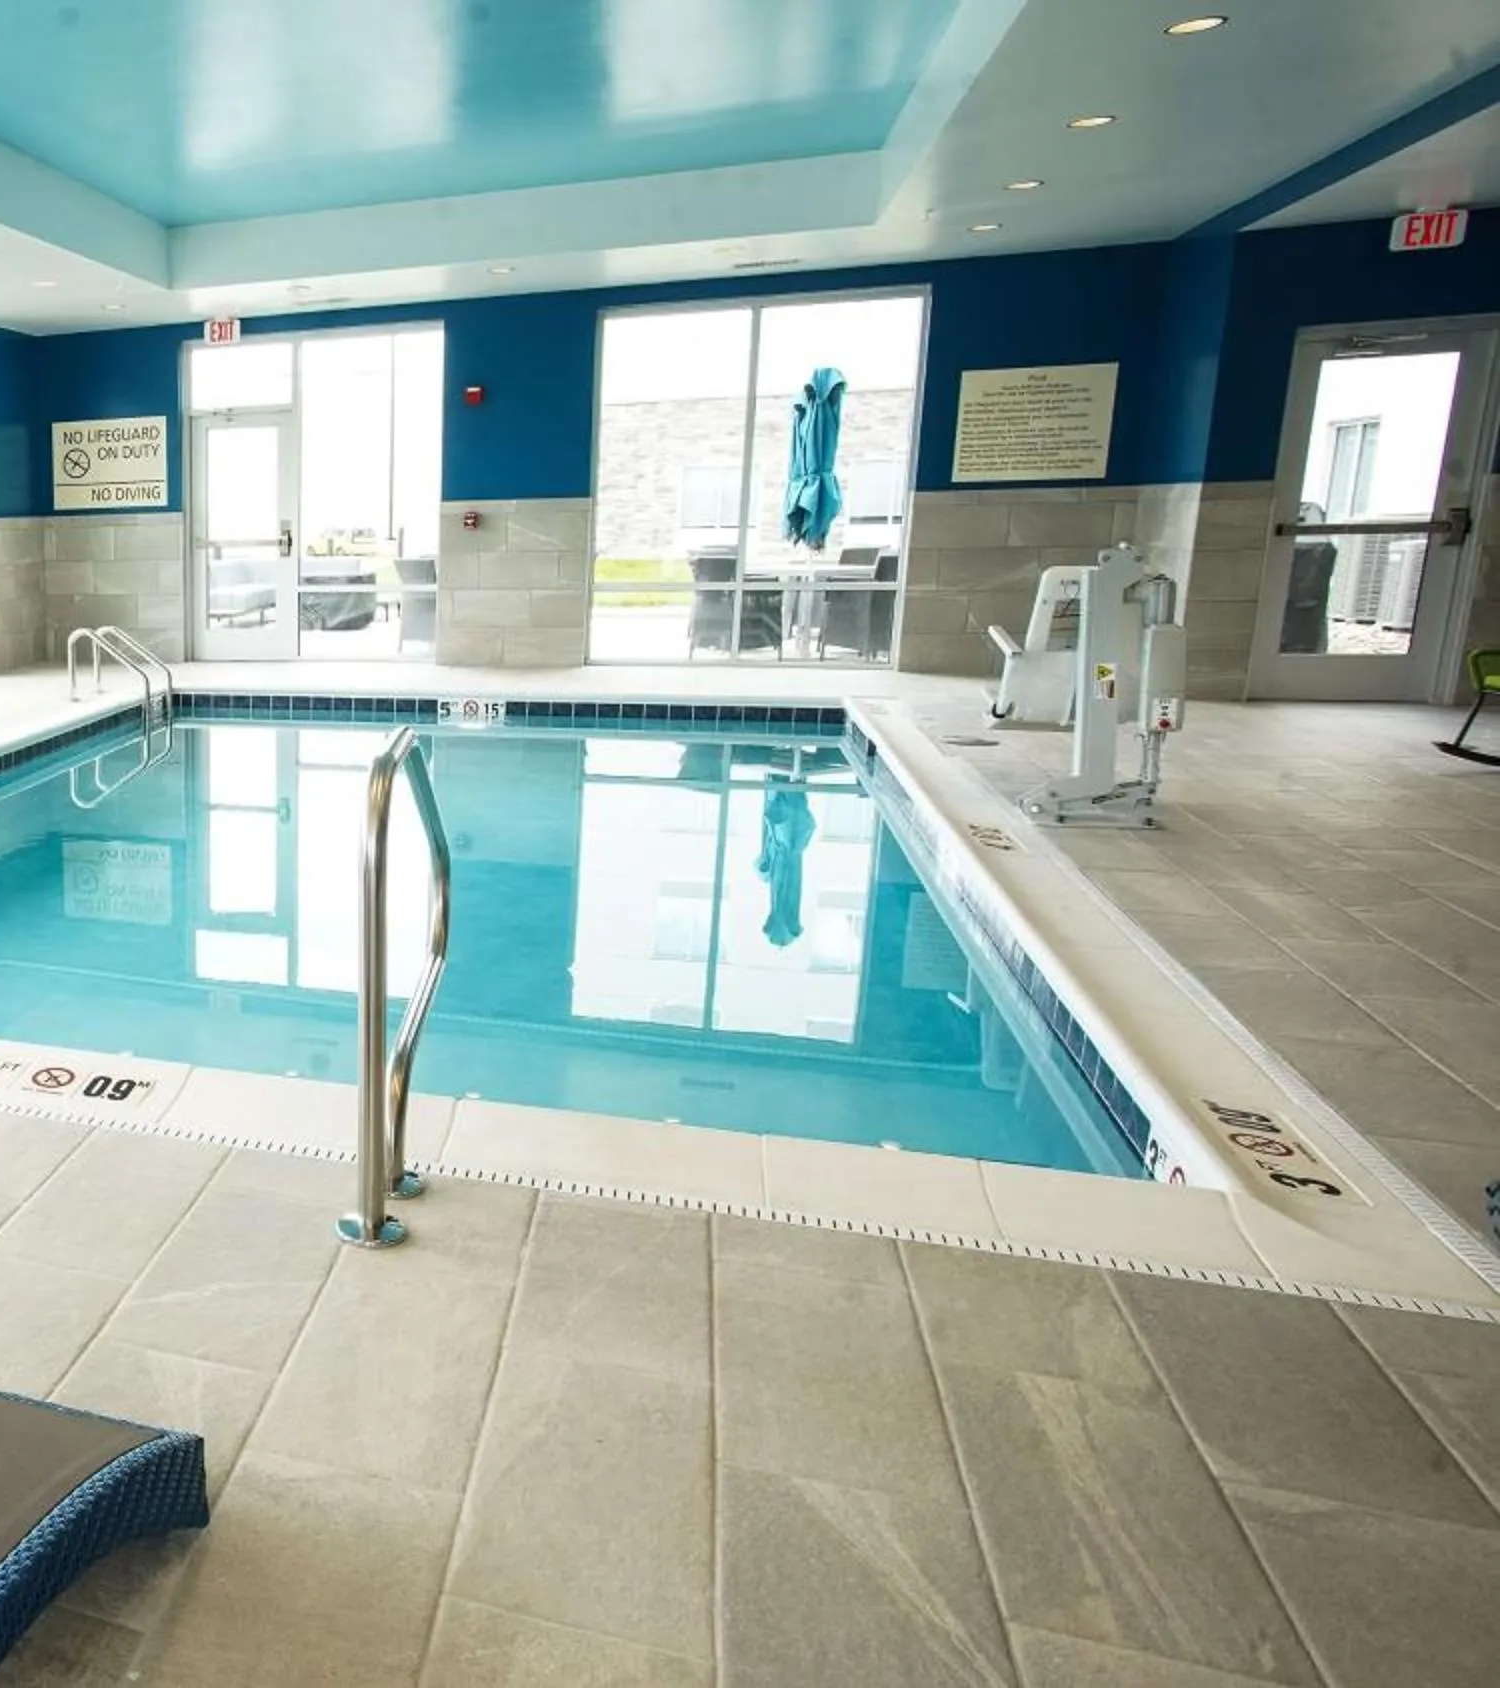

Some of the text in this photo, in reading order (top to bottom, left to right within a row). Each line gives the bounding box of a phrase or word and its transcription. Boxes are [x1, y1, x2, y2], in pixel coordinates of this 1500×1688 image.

[1404, 213, 1459, 246] EXIT
[211, 321, 233, 342] EXIT
[63, 426, 160, 444] NO LIFEGUARD
[97, 444, 161, 460] ON DUTY
[91, 486, 161, 501] NO DIVING
